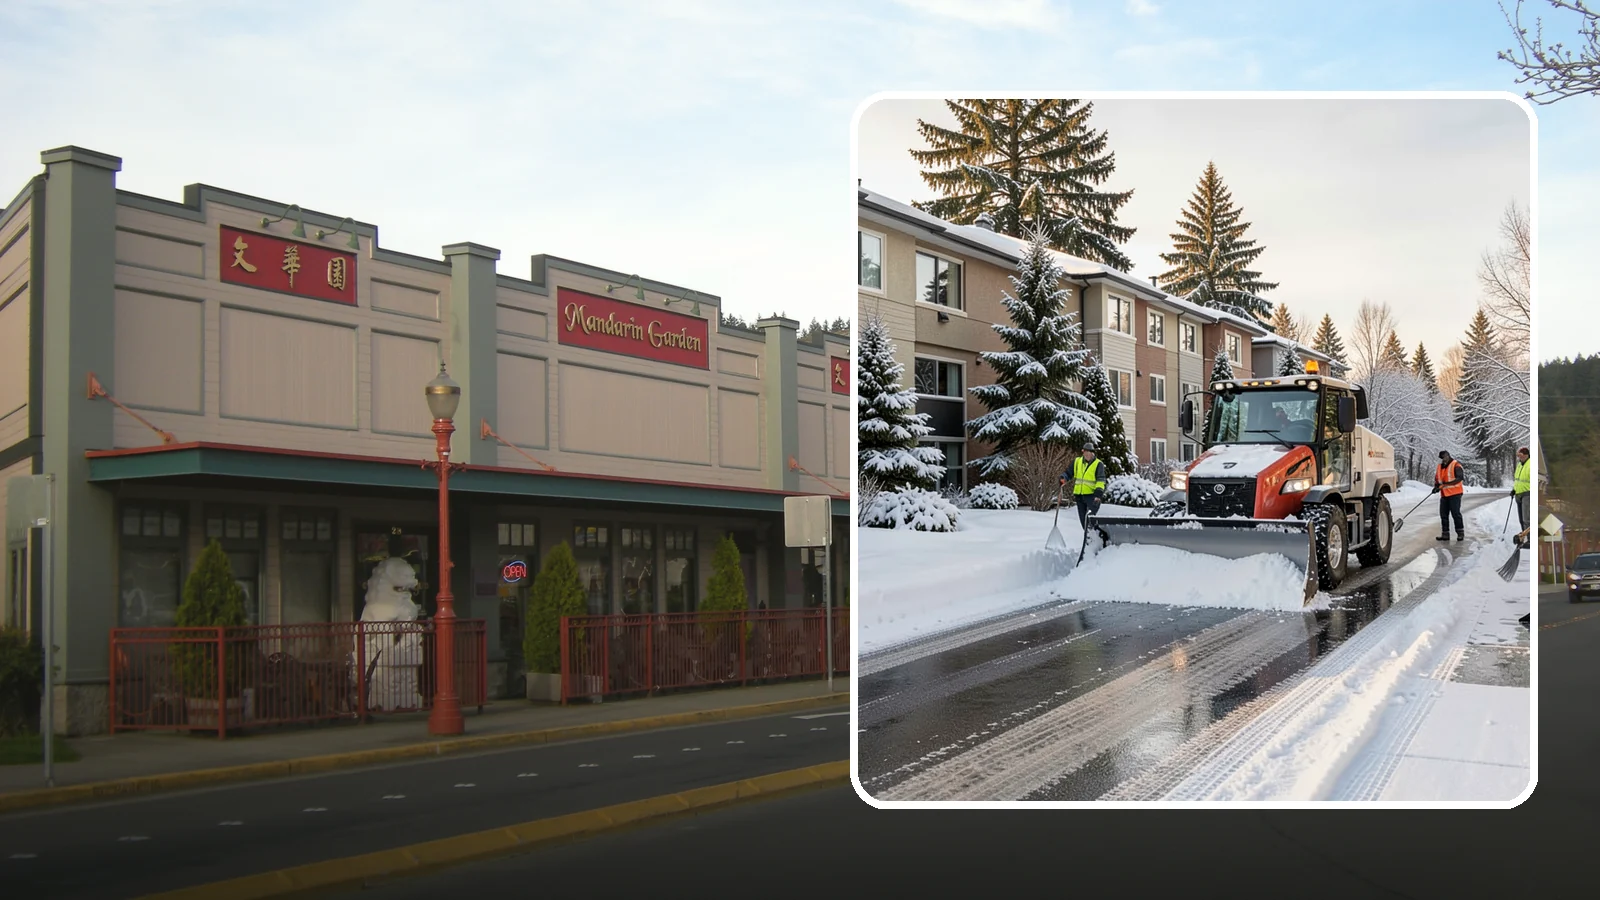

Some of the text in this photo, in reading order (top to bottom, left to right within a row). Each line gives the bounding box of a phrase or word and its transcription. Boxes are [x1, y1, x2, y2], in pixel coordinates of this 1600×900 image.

[231, 235, 346, 291] 文華園
[564, 302, 702, 352] Mandarin Garden
[502, 565, 528, 578] OPEN
